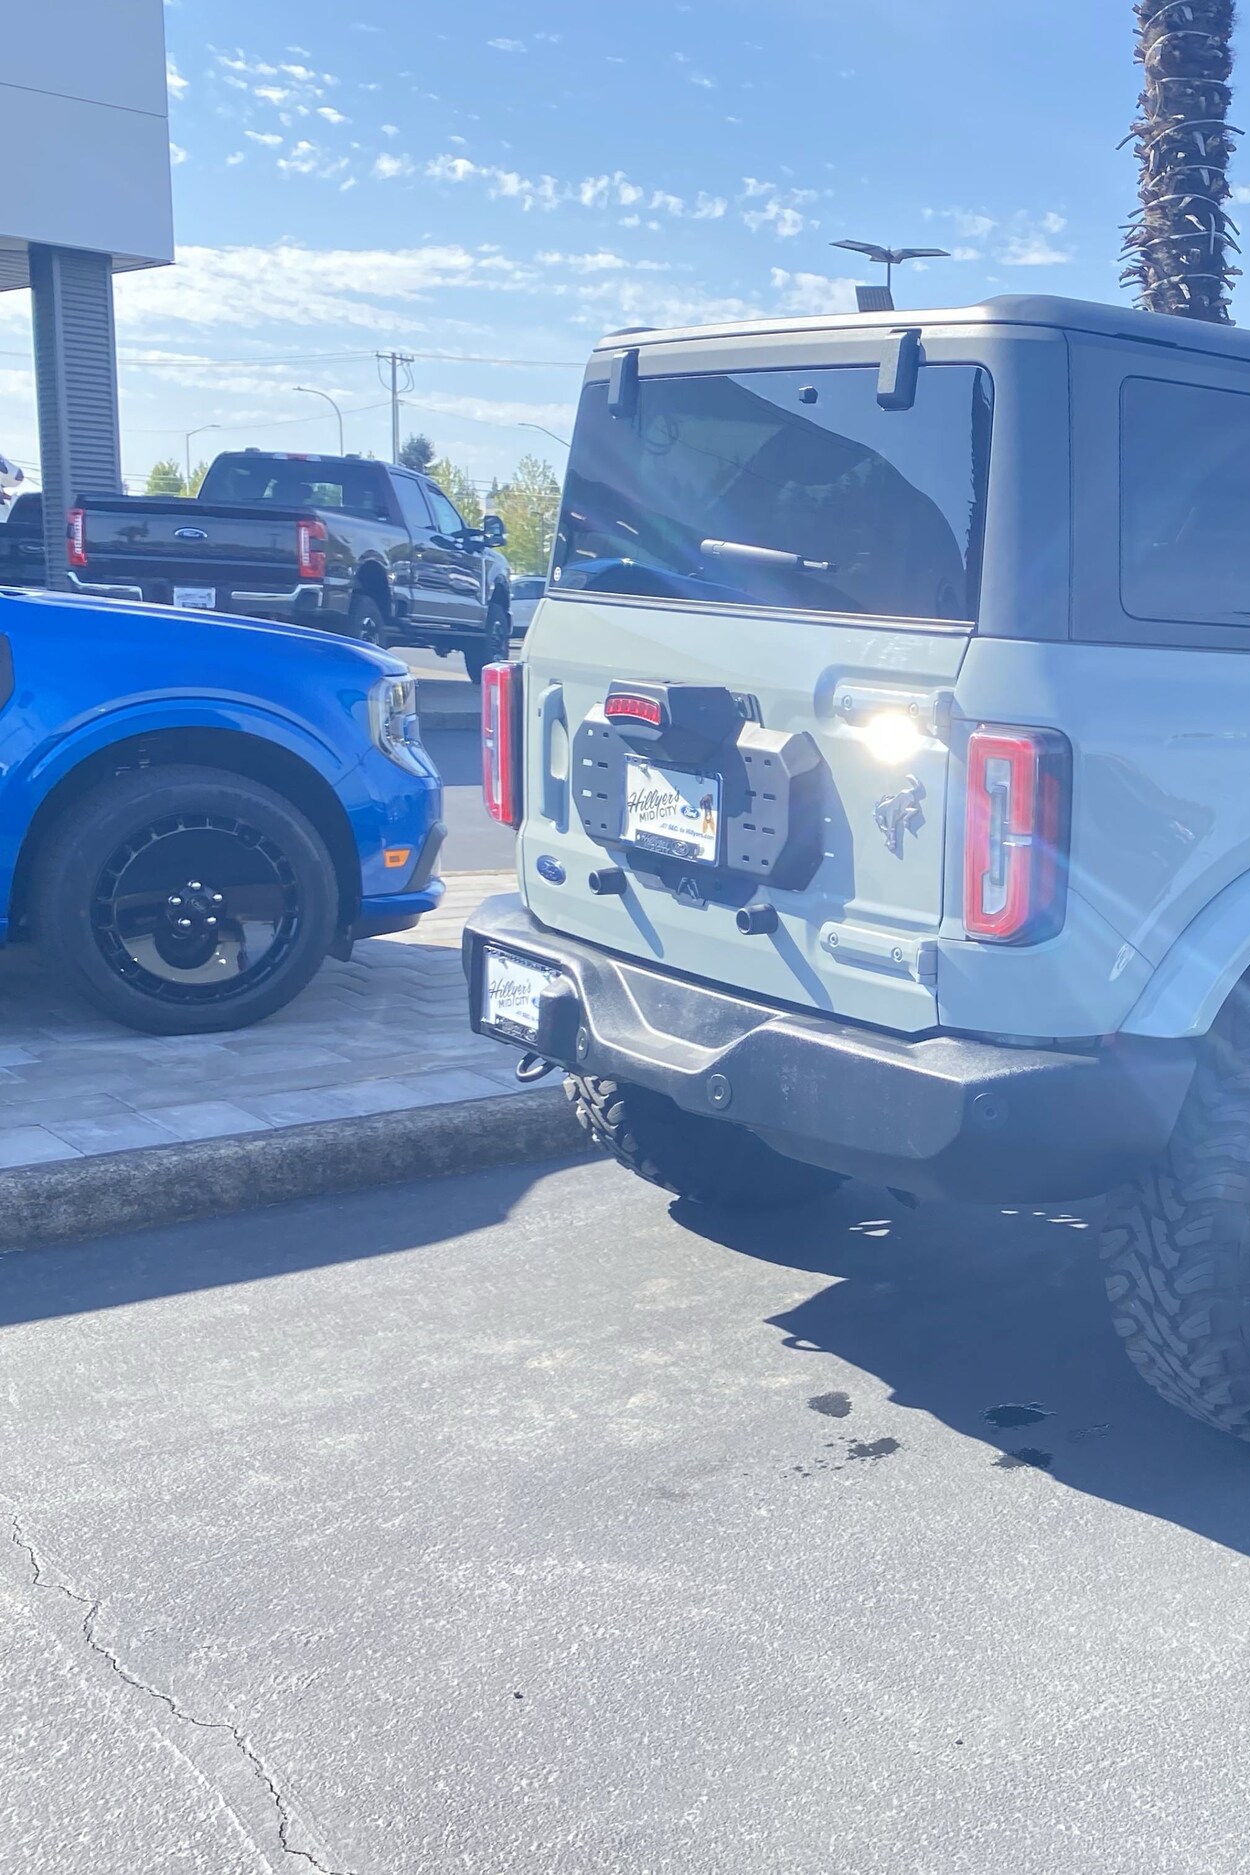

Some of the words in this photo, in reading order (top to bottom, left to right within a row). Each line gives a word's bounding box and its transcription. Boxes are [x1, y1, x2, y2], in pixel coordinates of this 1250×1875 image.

[627, 786, 681, 819] Hillyer's
[640, 811, 656, 823] MID
[659, 804, 678, 819] CITY
[488, 978, 532, 1003] Hillyer's
